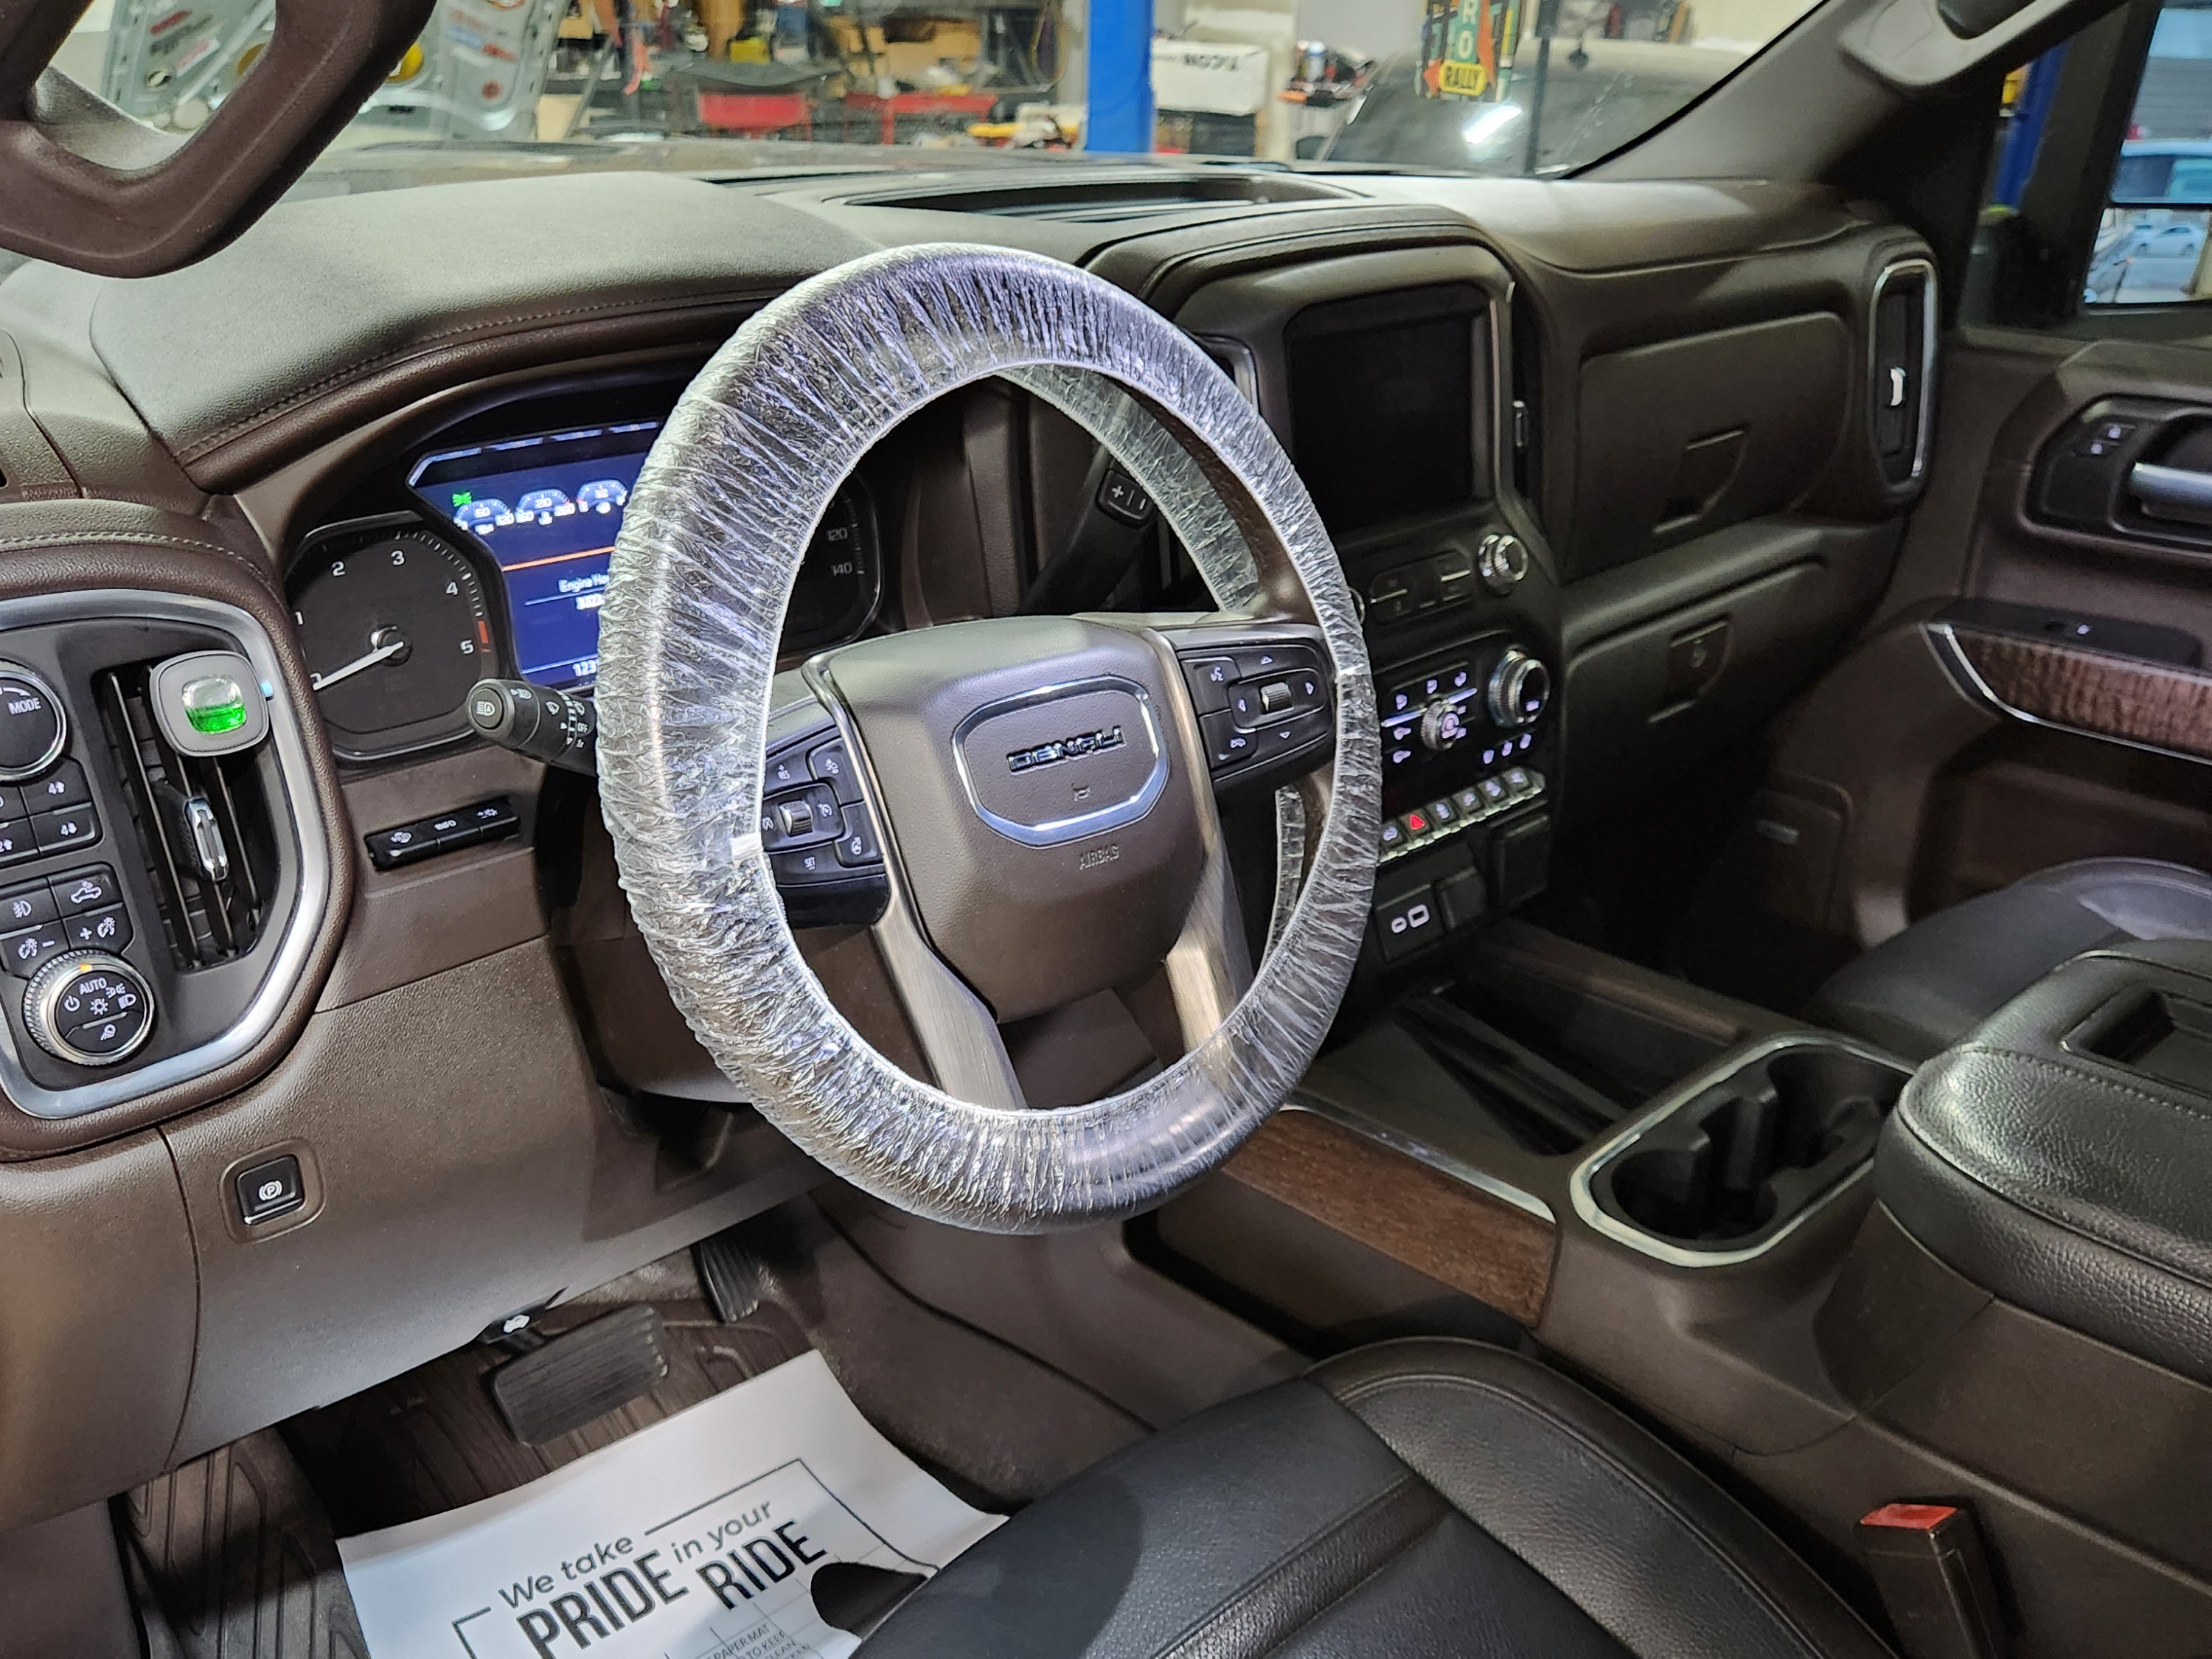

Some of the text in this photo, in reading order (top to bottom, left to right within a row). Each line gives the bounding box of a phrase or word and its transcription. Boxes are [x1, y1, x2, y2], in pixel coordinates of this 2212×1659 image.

[827, 527, 848, 542] 120
[390, 550, 406, 566] 3
[332, 561, 346, 577] 2
[831, 563, 853, 577] 140
[445, 581, 459, 596] 4
[558, 577, 593, 593] Engine
[295, 611, 304, 625] 1
[460, 639, 474, 655] 5
[8, 697, 42, 715] MODE
[577, 722, 589, 734] OFF
[1006, 726, 1125, 773] DENALI
[1079, 844, 1120, 870] AIRBAG
[79, 977, 108, 995] AUTO
[669, 1500, 773, 1564] in your
[498, 1535, 635, 1610] We take
[695, 1519, 828, 1611] RIDE
[516, 1549, 689, 1659] PRIDE
[747, 1624, 771, 1643] MAT
